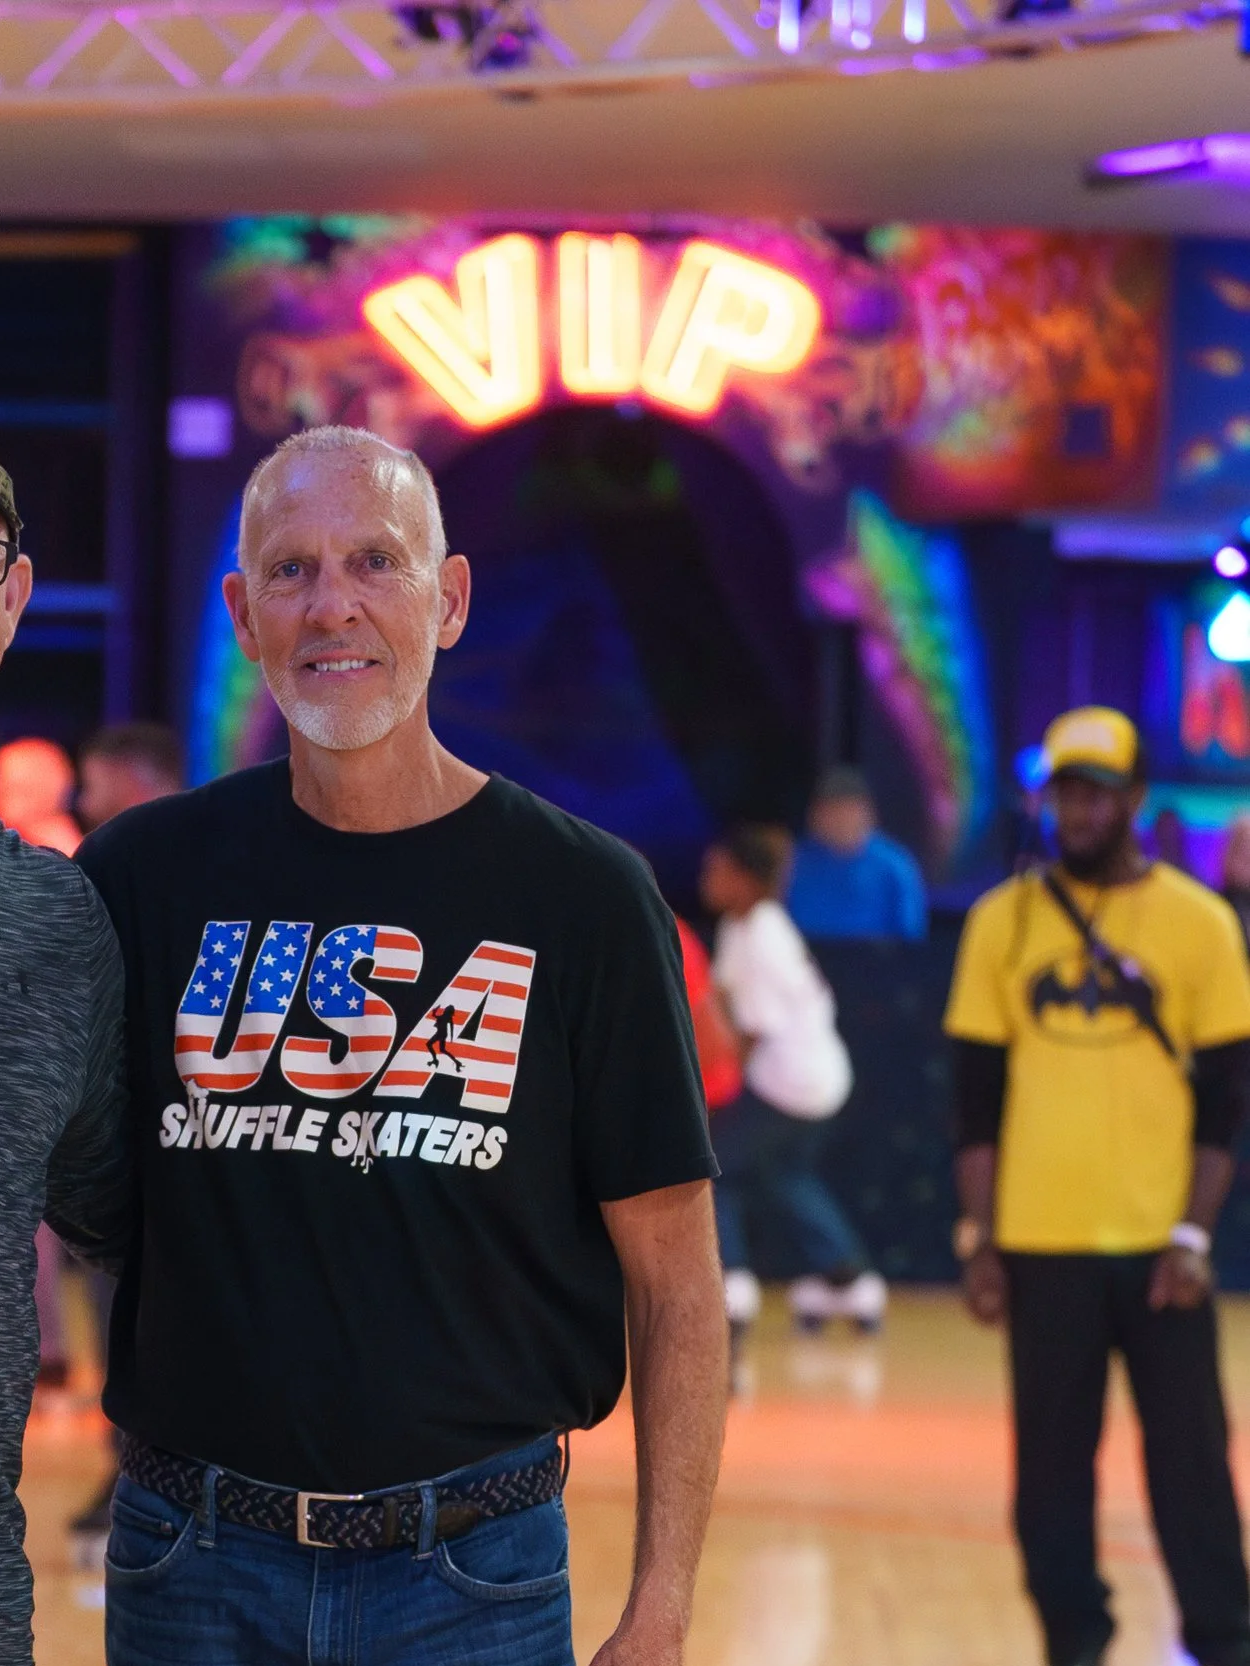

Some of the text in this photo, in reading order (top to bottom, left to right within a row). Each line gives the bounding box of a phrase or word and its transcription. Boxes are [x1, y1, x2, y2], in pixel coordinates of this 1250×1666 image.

[363, 231, 820, 427] VIP
[175, 920, 536, 1113] USA
[159, 1102, 507, 1170] SHUFFLE SKATERS
